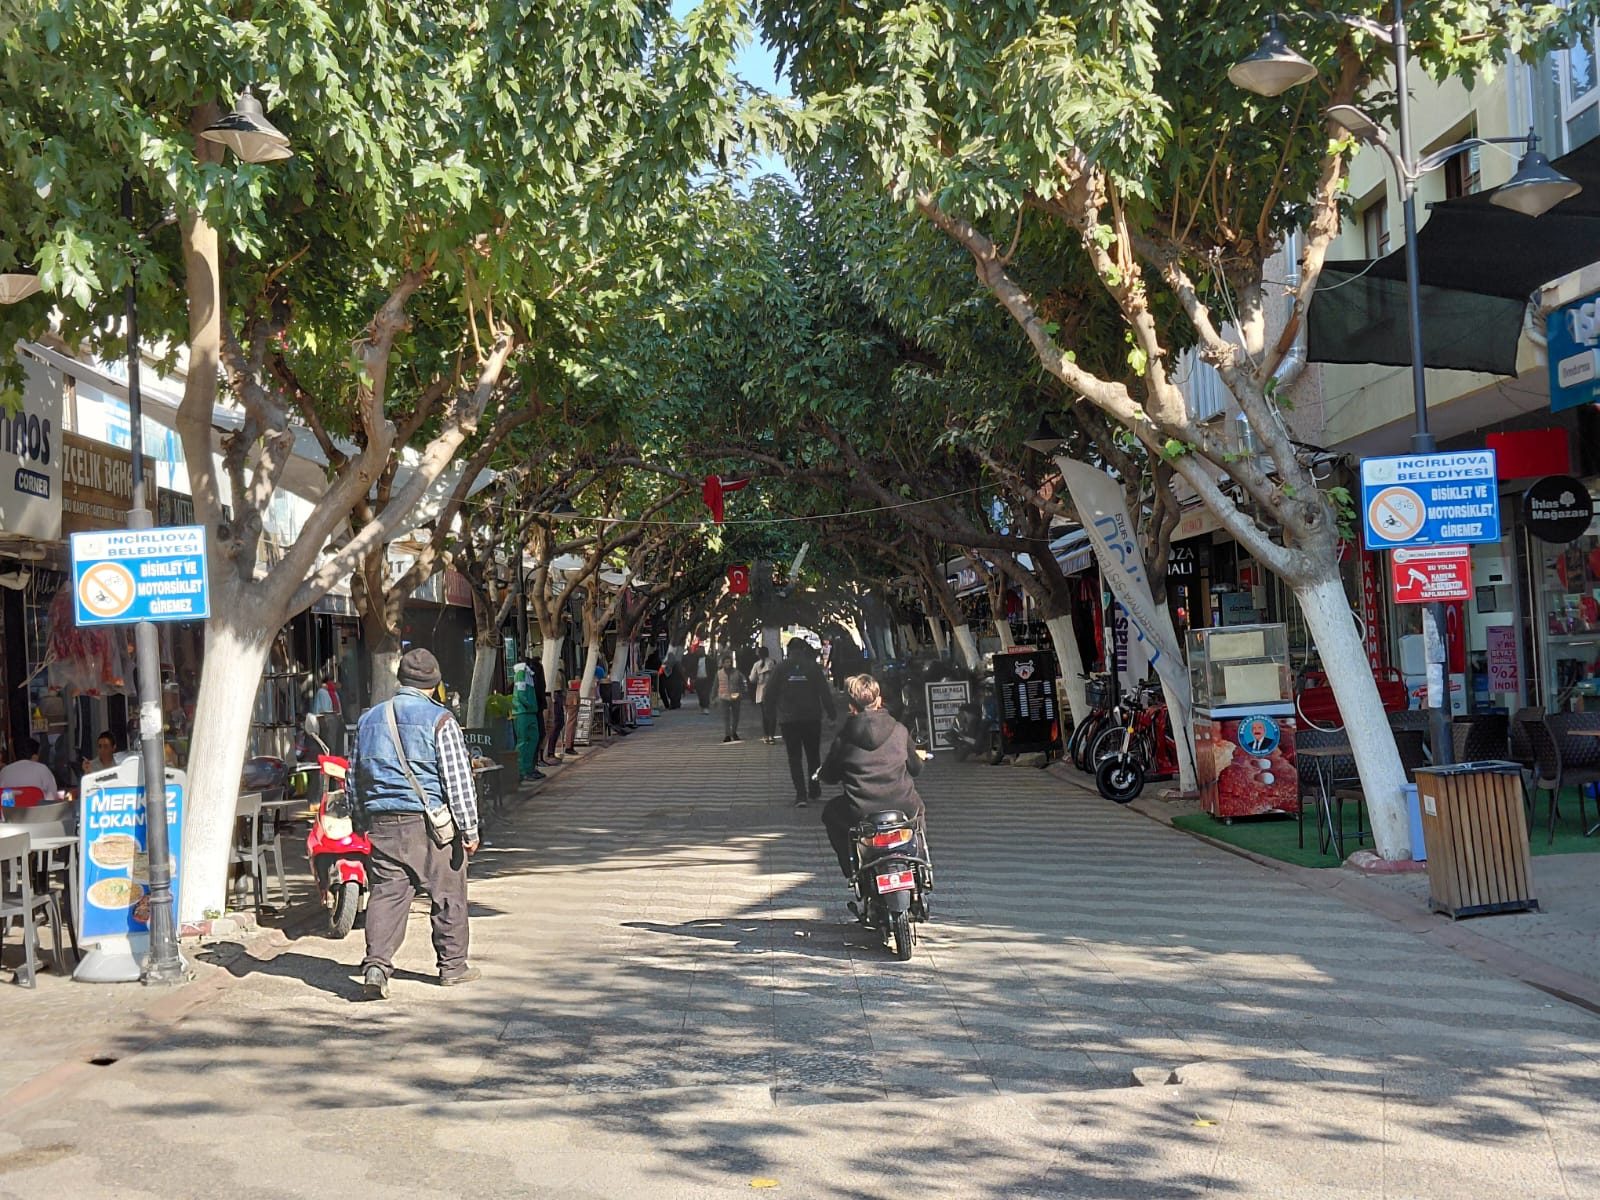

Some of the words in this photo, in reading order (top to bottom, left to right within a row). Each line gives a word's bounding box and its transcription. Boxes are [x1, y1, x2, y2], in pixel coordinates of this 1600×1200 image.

[63, 444, 101, 494] ZÇELİK
[105, 457, 154, 502] BAHAT
[18, 472, 48, 496] CORNER
[1431, 485, 1473, 501] BİSİKLET
[1474, 485, 1488, 498] VE
[1428, 501, 1493, 520] MOTORSİKLET
[1531, 497, 1559, 509] İhlas
[1532, 509, 1589, 520] Mağazası
[1440, 521, 1483, 538] GİREMEZ
[140, 560, 182, 577] BİSİKLET
[184, 560, 198, 574] VE
[137, 577, 203, 596] MOTORSİKLET
[149, 597, 192, 614] GİREMEZ
[1364, 561, 1379, 670] KAVURMA
[1491, 665, 1517, 679] %2
[464, 733, 492, 746] RBER
[92, 791, 176, 812] MERKZ
[89, 811, 177, 828] LOKANSI
